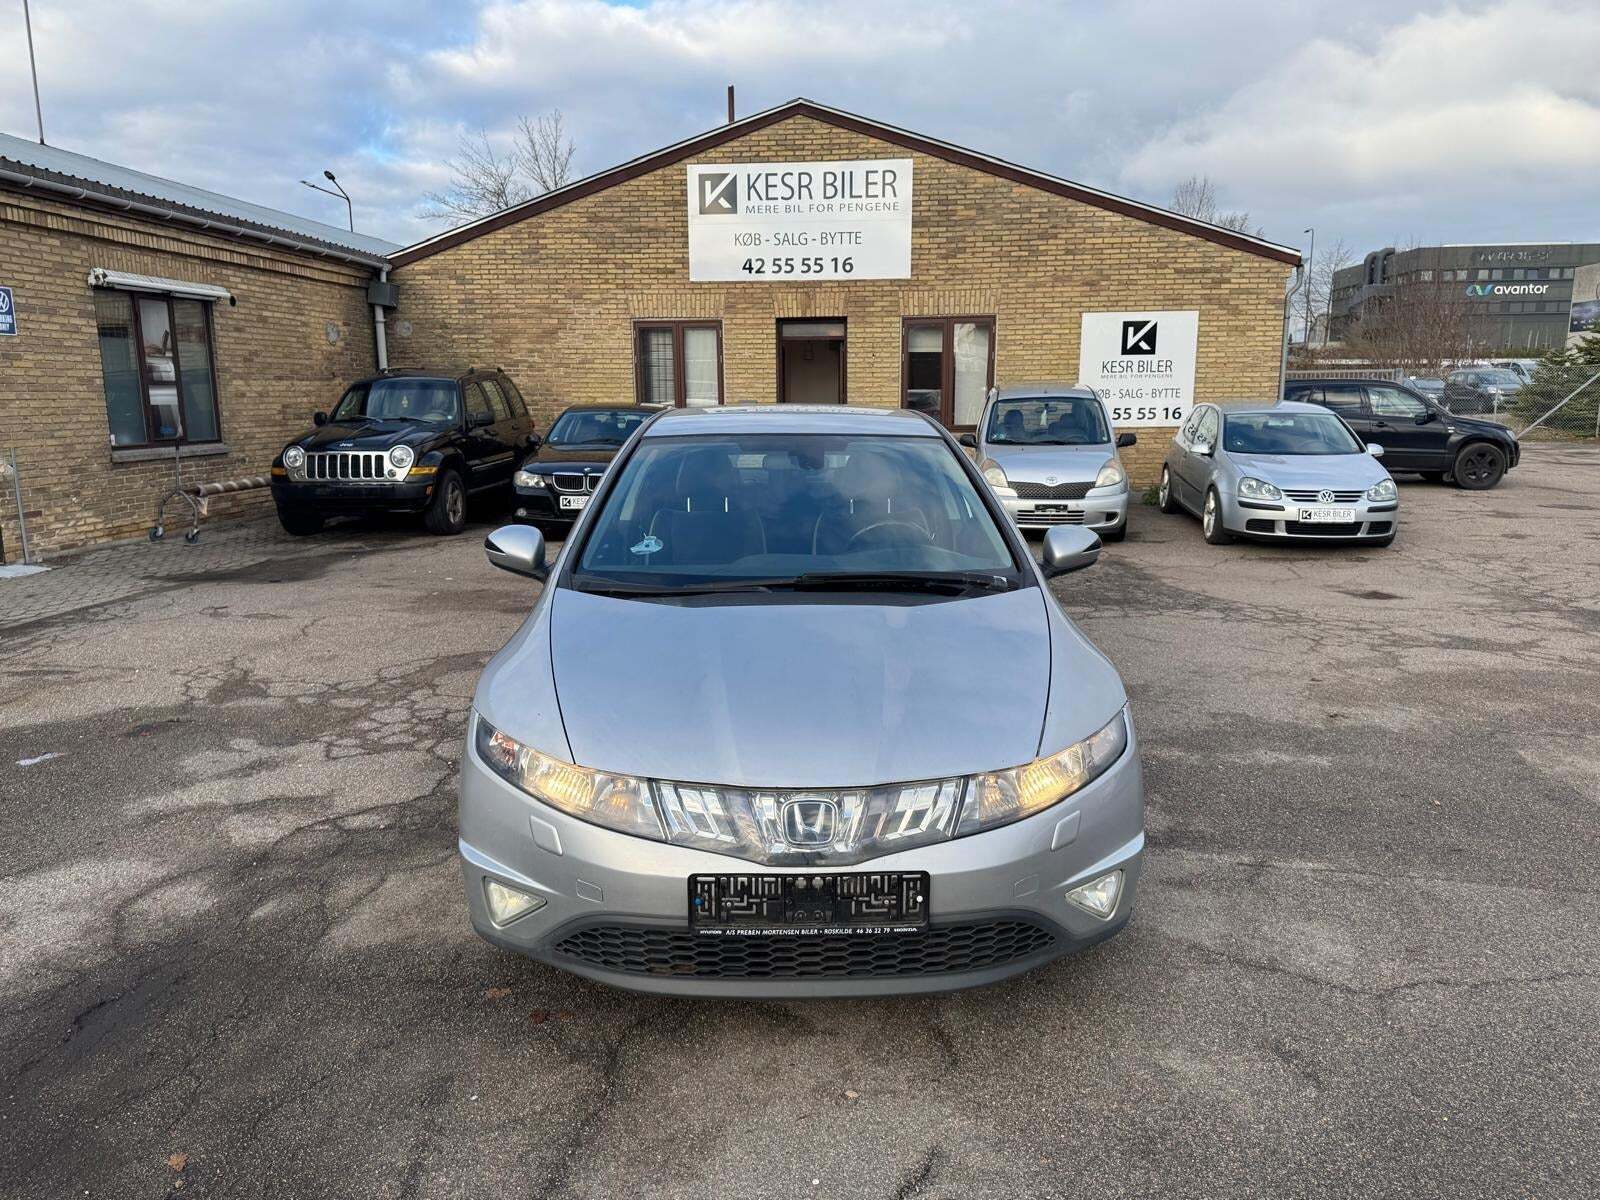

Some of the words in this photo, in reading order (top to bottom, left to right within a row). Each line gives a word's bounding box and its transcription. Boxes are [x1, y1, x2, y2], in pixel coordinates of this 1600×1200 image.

[746, 172, 813, 201] KESR
[823, 169, 897, 200] BILER
[745, 204, 780, 214] MERE
[785, 204, 804, 214] BIL
[809, 203, 834, 213] FOR
[839, 201, 900, 212] PENGENE
[734, 232, 762, 247] KØB
[774, 232, 808, 246] SALG
[820, 231, 862, 245] BYTTE
[742, 258, 766, 274] 42
[772, 258, 795, 274] 55
[801, 257, 824, 273] 55
[831, 257, 854, 273] 16
[1494, 283, 1549, 295] avantor
[1102, 360, 1134, 374] KESR
[1137, 360, 1173, 373] BILER
[1097, 388, 1111, 399] ØB
[1118, 388, 1144, 399] SALG
[1151, 388, 1181, 398] BYTTE
[1112, 407, 1132, 420] 55
[1136, 407, 1157, 420] 55
[1162, 407, 1182, 420] 16
